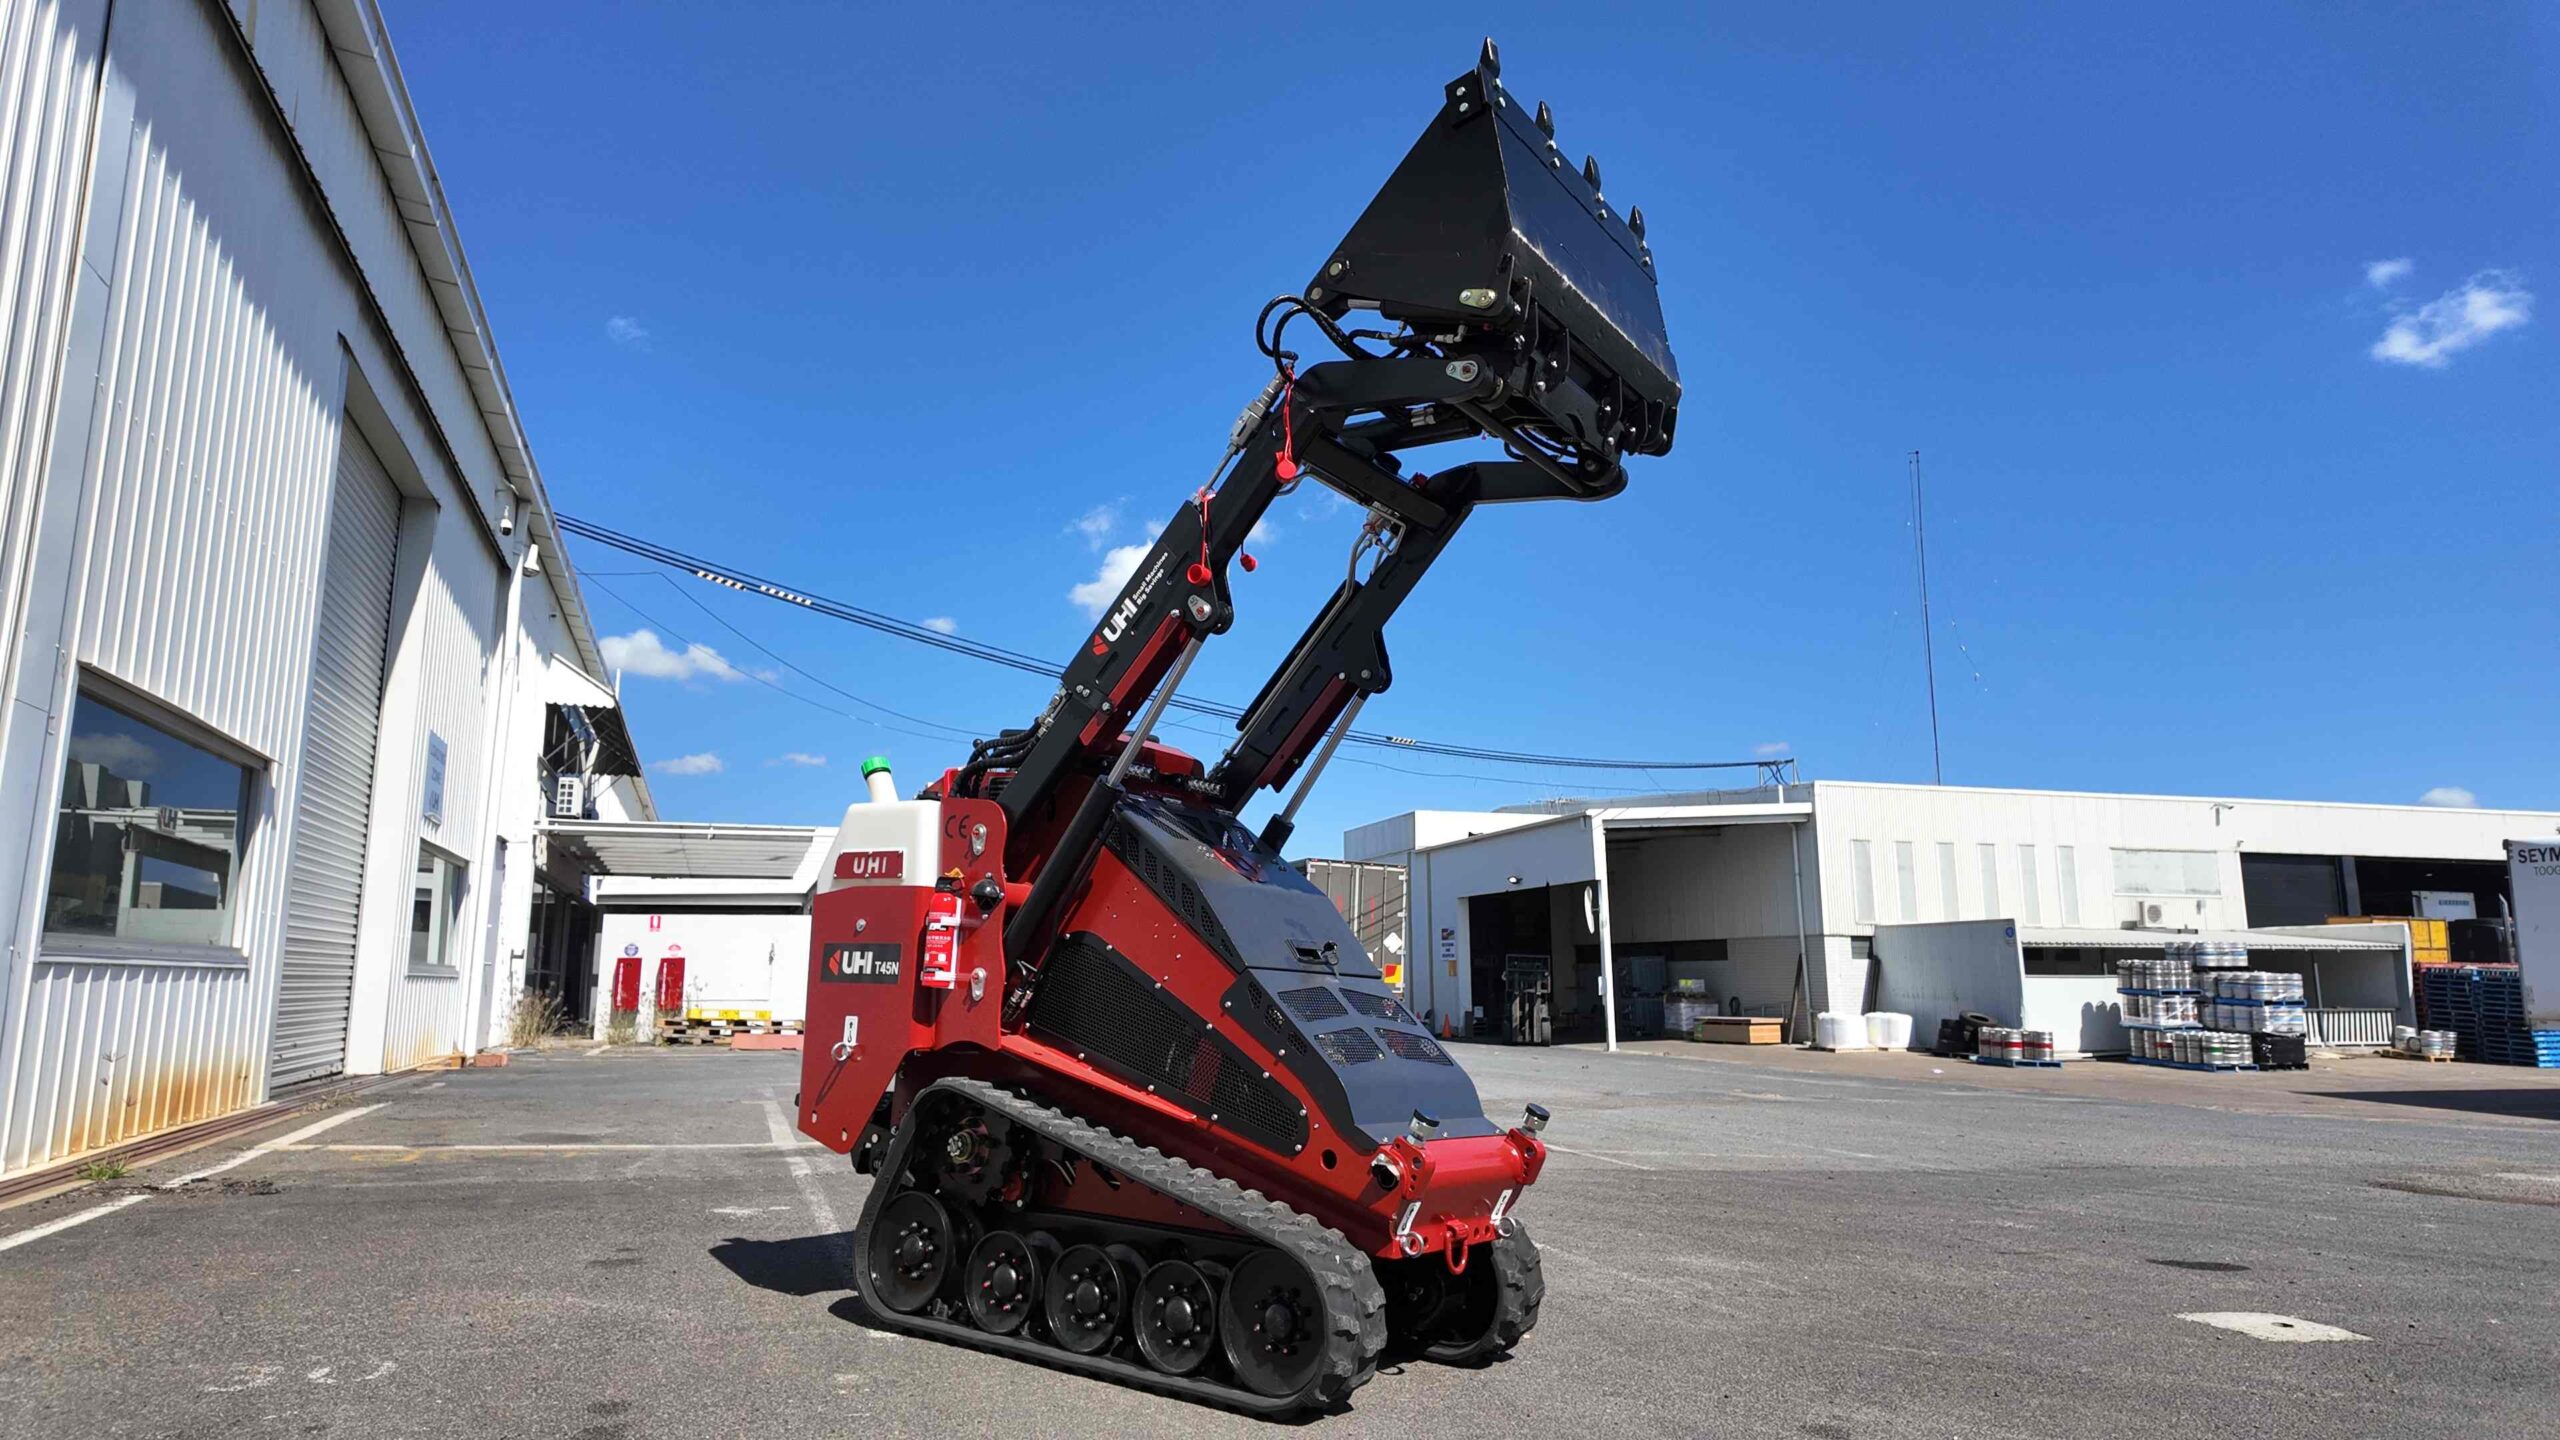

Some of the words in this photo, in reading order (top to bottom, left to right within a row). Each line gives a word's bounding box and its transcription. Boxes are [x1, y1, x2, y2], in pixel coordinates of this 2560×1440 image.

[1132, 580, 1147, 600] Small
[1145, 552, 1168, 582] Machines
[1136, 593, 1147, 605] Big
[1144, 568, 1164, 594] Savings
[1102, 597, 1138, 642] UHI
[945, 815, 970, 838] CE
[853, 856, 887, 874] UHI
[2518, 847, 2560, 863] SEYM
[842, 951, 874, 975] UHI
[874, 961, 899, 975] T45N
